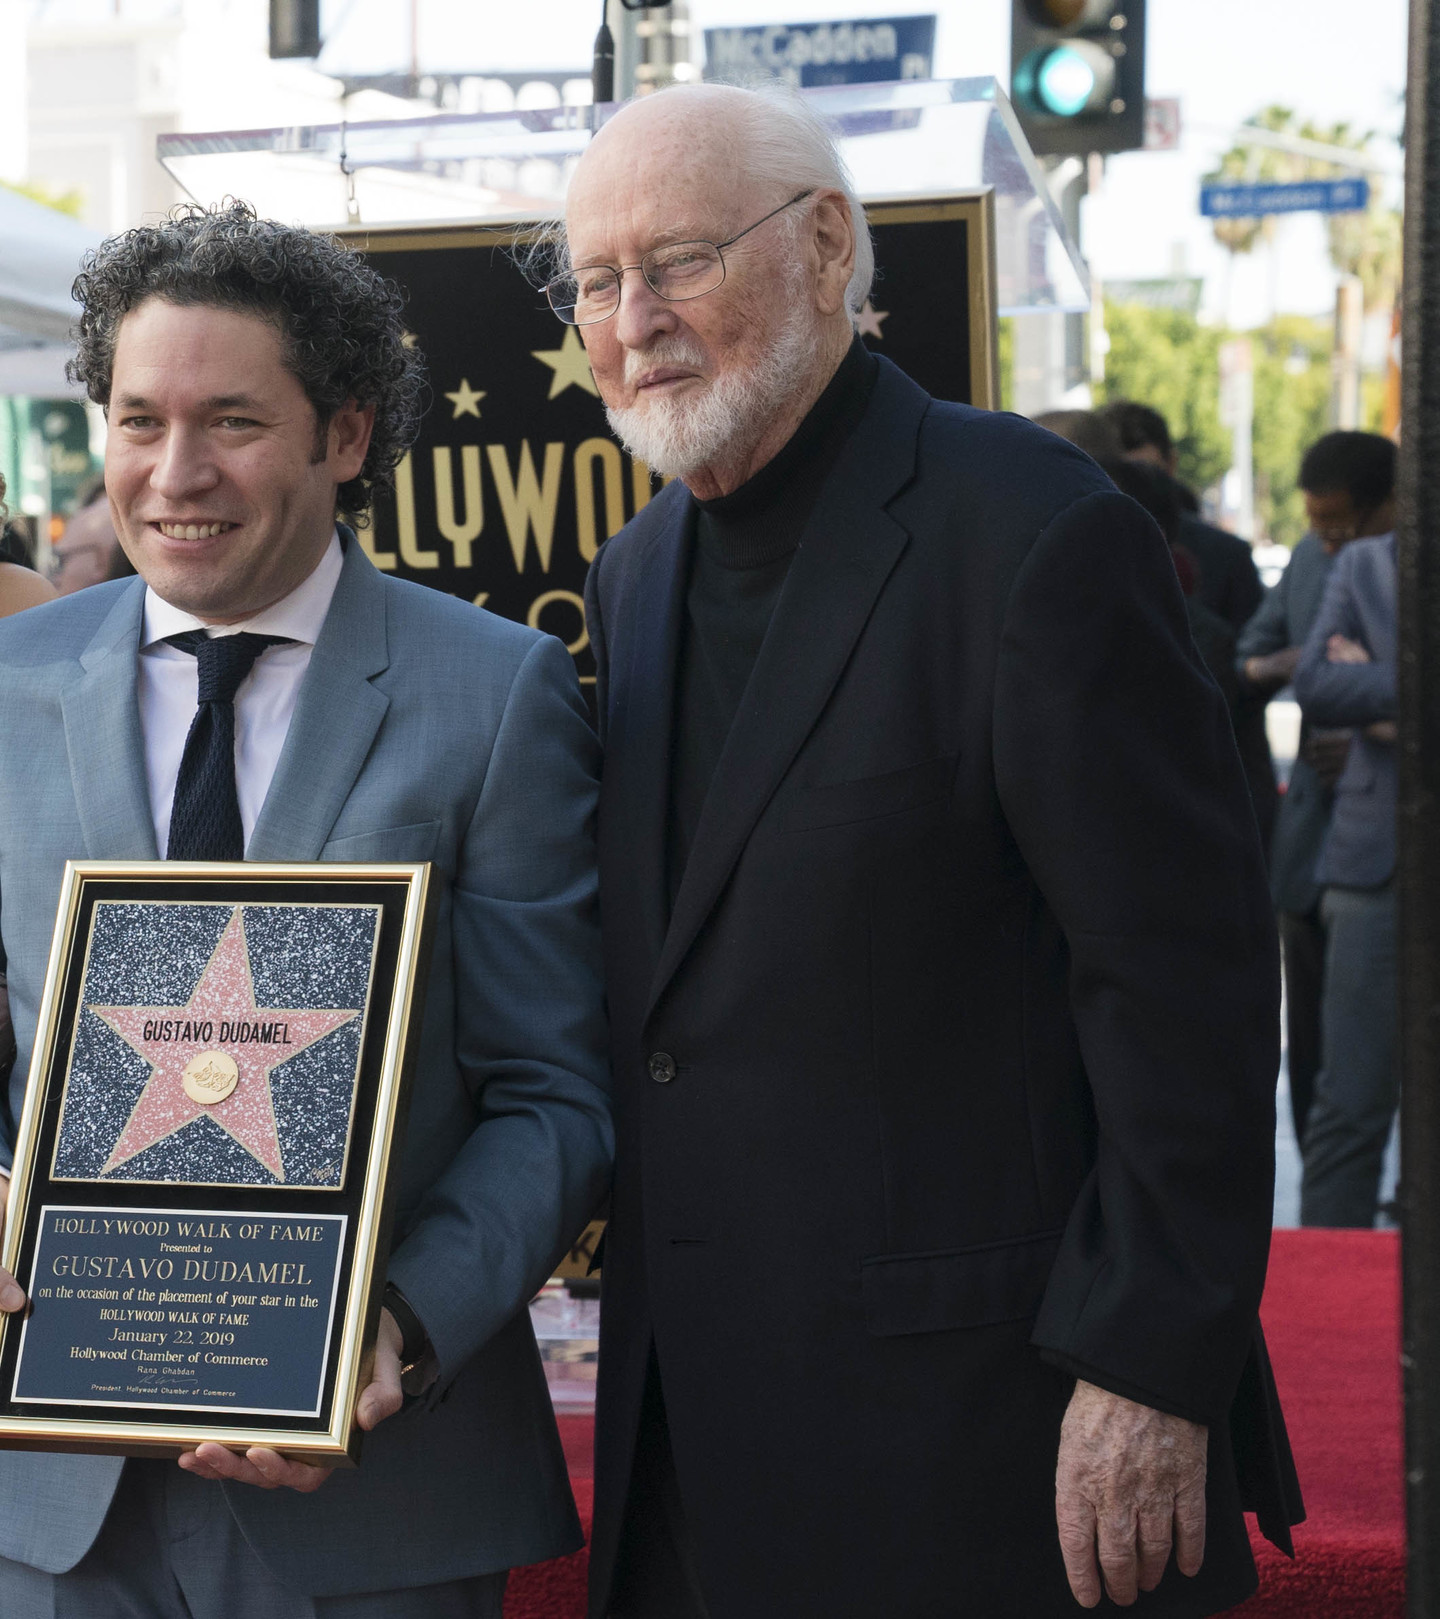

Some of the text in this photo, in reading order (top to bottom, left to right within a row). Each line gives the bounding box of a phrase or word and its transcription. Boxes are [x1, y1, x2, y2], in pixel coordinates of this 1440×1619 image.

[713, 22, 898, 72] McCadden
[143, 1020, 292, 1044] GUSTAVO DUDAMEL
[53, 1218, 324, 1242] HOLLYWOOD WALK OF FAME
[160, 1242, 213, 1254] Presented to
[52, 1255, 312, 1285] GUSTAVO DUDAMEL
[38, 1285, 319, 1308] on the occasion of the placement of your star in the
[99, 1308, 250, 1326] HOLLYWOOD WALK OF FAME
[107, 1327, 168, 1346] January
[199, 1331, 235, 1346] 2019
[69, 1346, 269, 1367] Hollywood Chamber of Commerce
[137, 1365, 158, 1375] Rana
[126, 1385, 158, 1394] Hollywood
[160, 1387, 190, 1396] Chamber
[192, 1388, 200, 1396] of
[203, 1389, 237, 1398] Commerce
